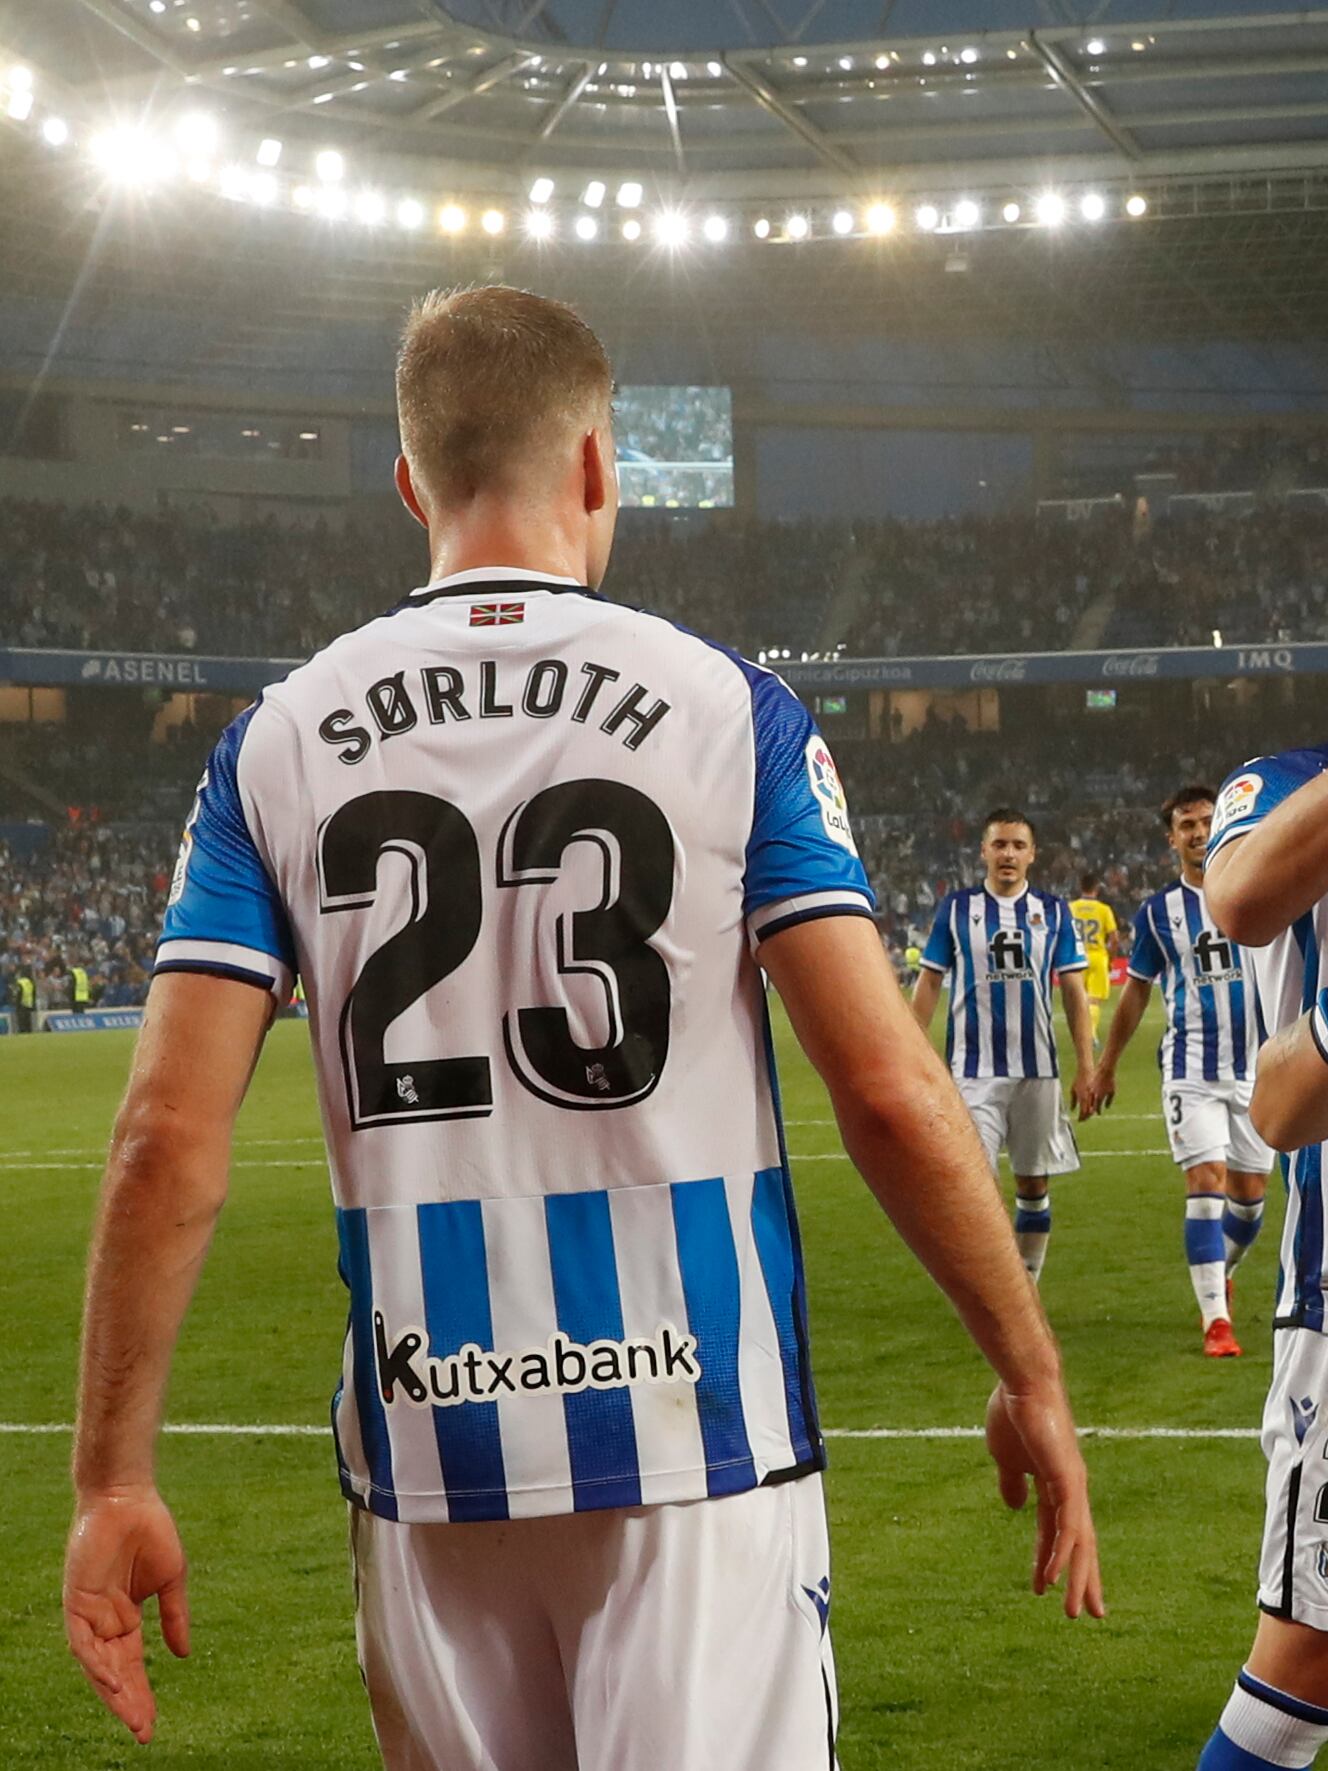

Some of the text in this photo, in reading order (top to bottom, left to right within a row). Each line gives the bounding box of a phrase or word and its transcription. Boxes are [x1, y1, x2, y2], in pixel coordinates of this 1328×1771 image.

[104, 658, 208, 684] ASENEL
[1238, 650, 1295, 671] IMQ
[318, 660, 671, 764] SØRLOTH
[316, 778, 675, 1131] 23
[1170, 1094, 1182, 1125] 3
[374, 1310, 695, 1403] Kutxabank
